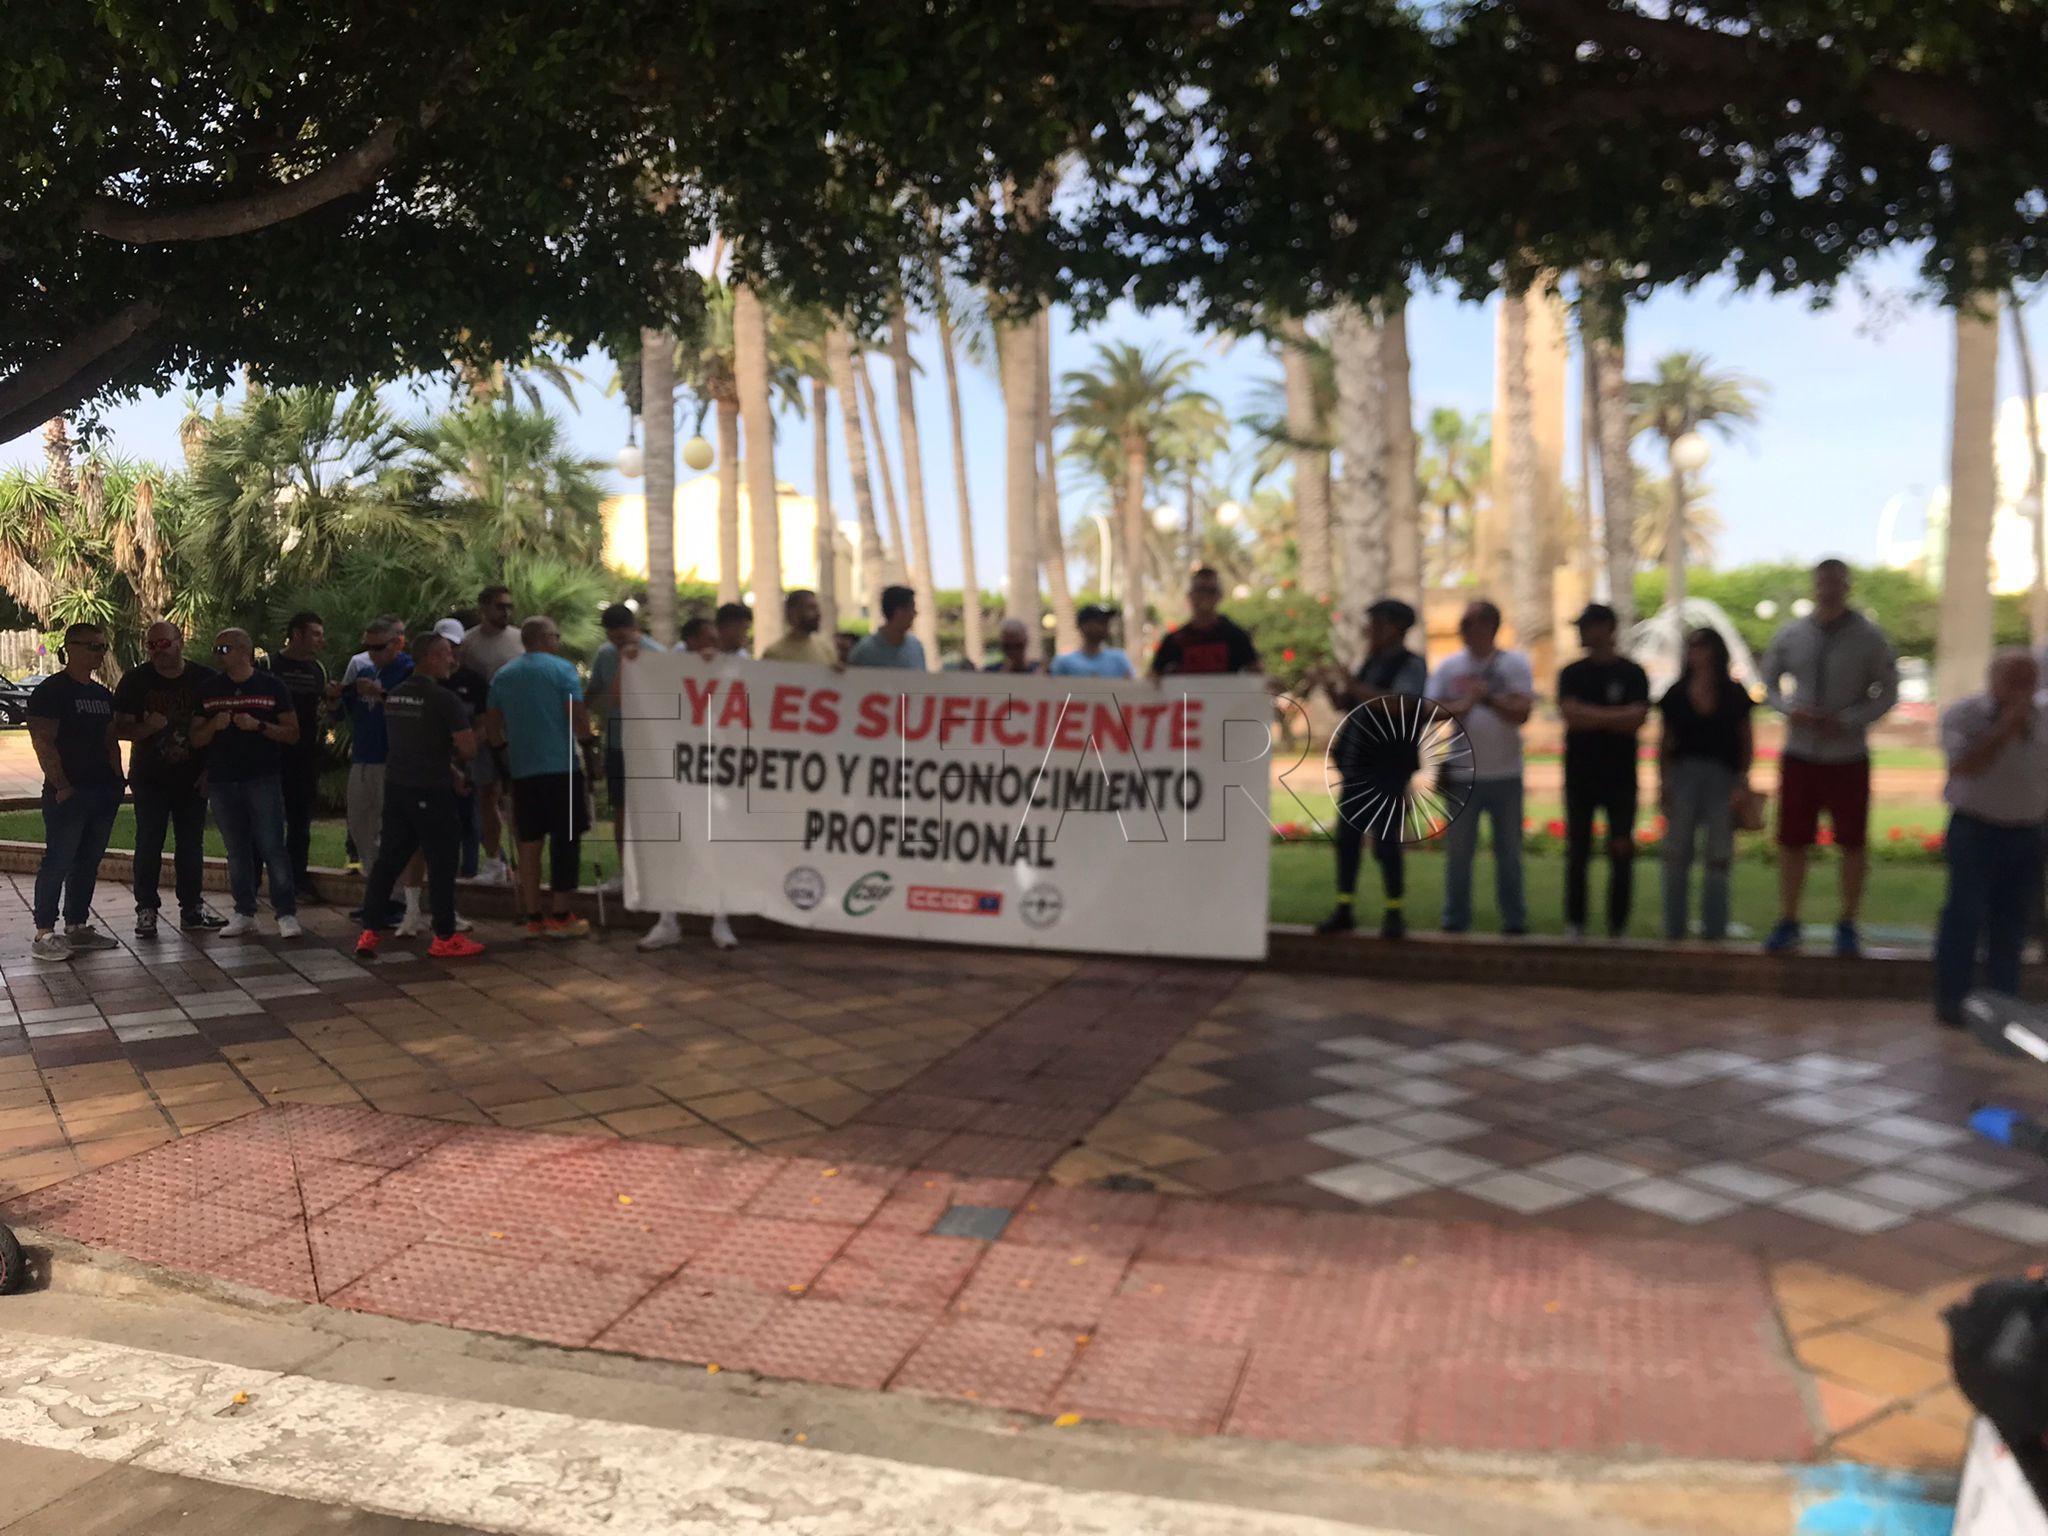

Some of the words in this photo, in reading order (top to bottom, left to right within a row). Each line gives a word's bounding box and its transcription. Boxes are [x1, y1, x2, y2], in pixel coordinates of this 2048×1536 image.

[682, 676, 754, 730] YA
[768, 683, 843, 736] ES
[854, 690, 1205, 753] SUFICIENTE
[675, 741, 827, 793] RESPETO
[837, 752, 861, 796] Y
[867, 755, 1204, 813] RECONOCIMIENTO
[803, 808, 1055, 868] PROFESIONAL
